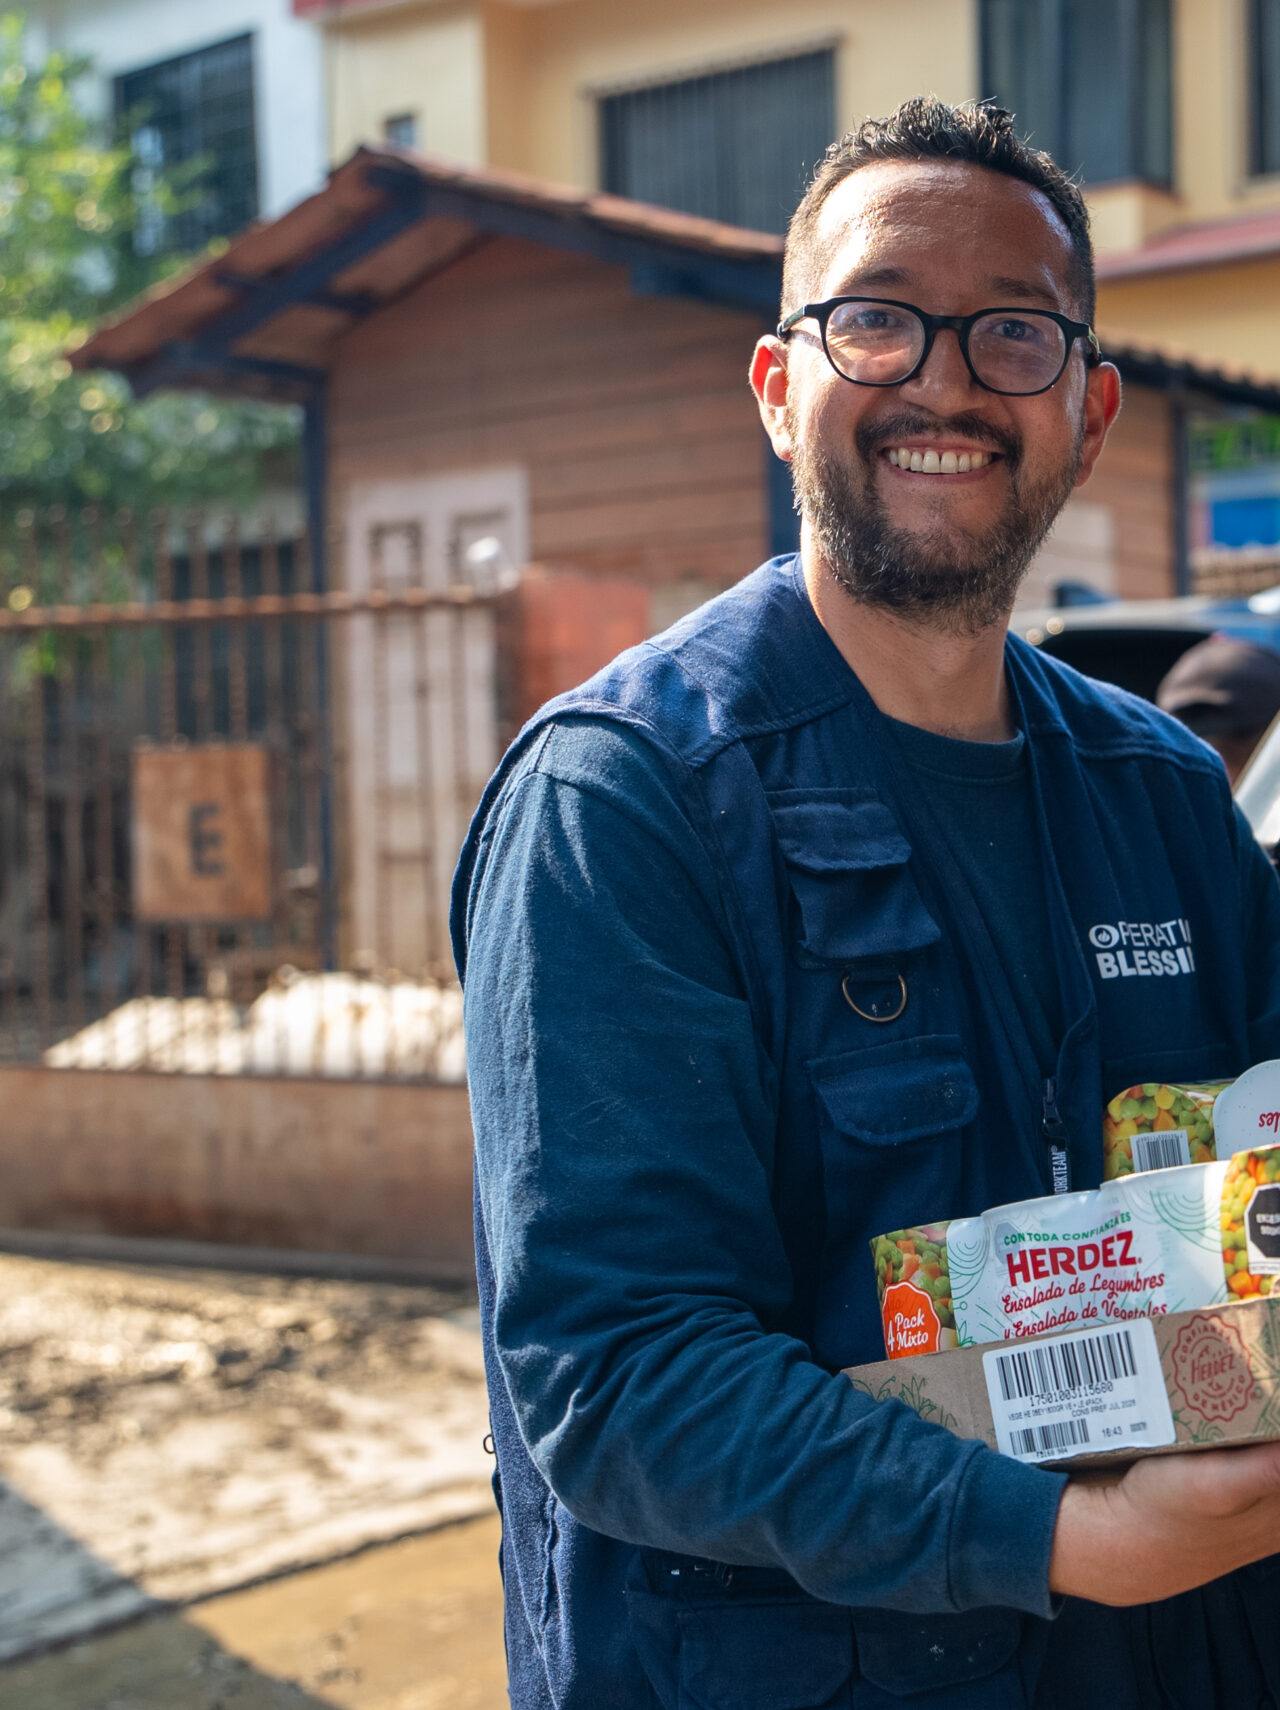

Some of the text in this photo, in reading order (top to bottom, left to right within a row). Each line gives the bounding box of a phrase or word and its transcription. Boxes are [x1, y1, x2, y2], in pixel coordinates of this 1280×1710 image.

[188, 803, 224, 876] E
[1089, 918, 1192, 949] OPERATI
[1004, 1211, 1132, 1246] CON TODA CONFIANZA ES
[1006, 1230, 1137, 1287] HERDEZ
[1002, 1272, 1165, 1314] Ensalada de Legumbres
[887, 1307, 925, 1352] 4 Pack
[1013, 1306, 1079, 1338] Ensalada
[1081, 1302, 1098, 1319] de
[897, 1330, 929, 1351] Mixto
